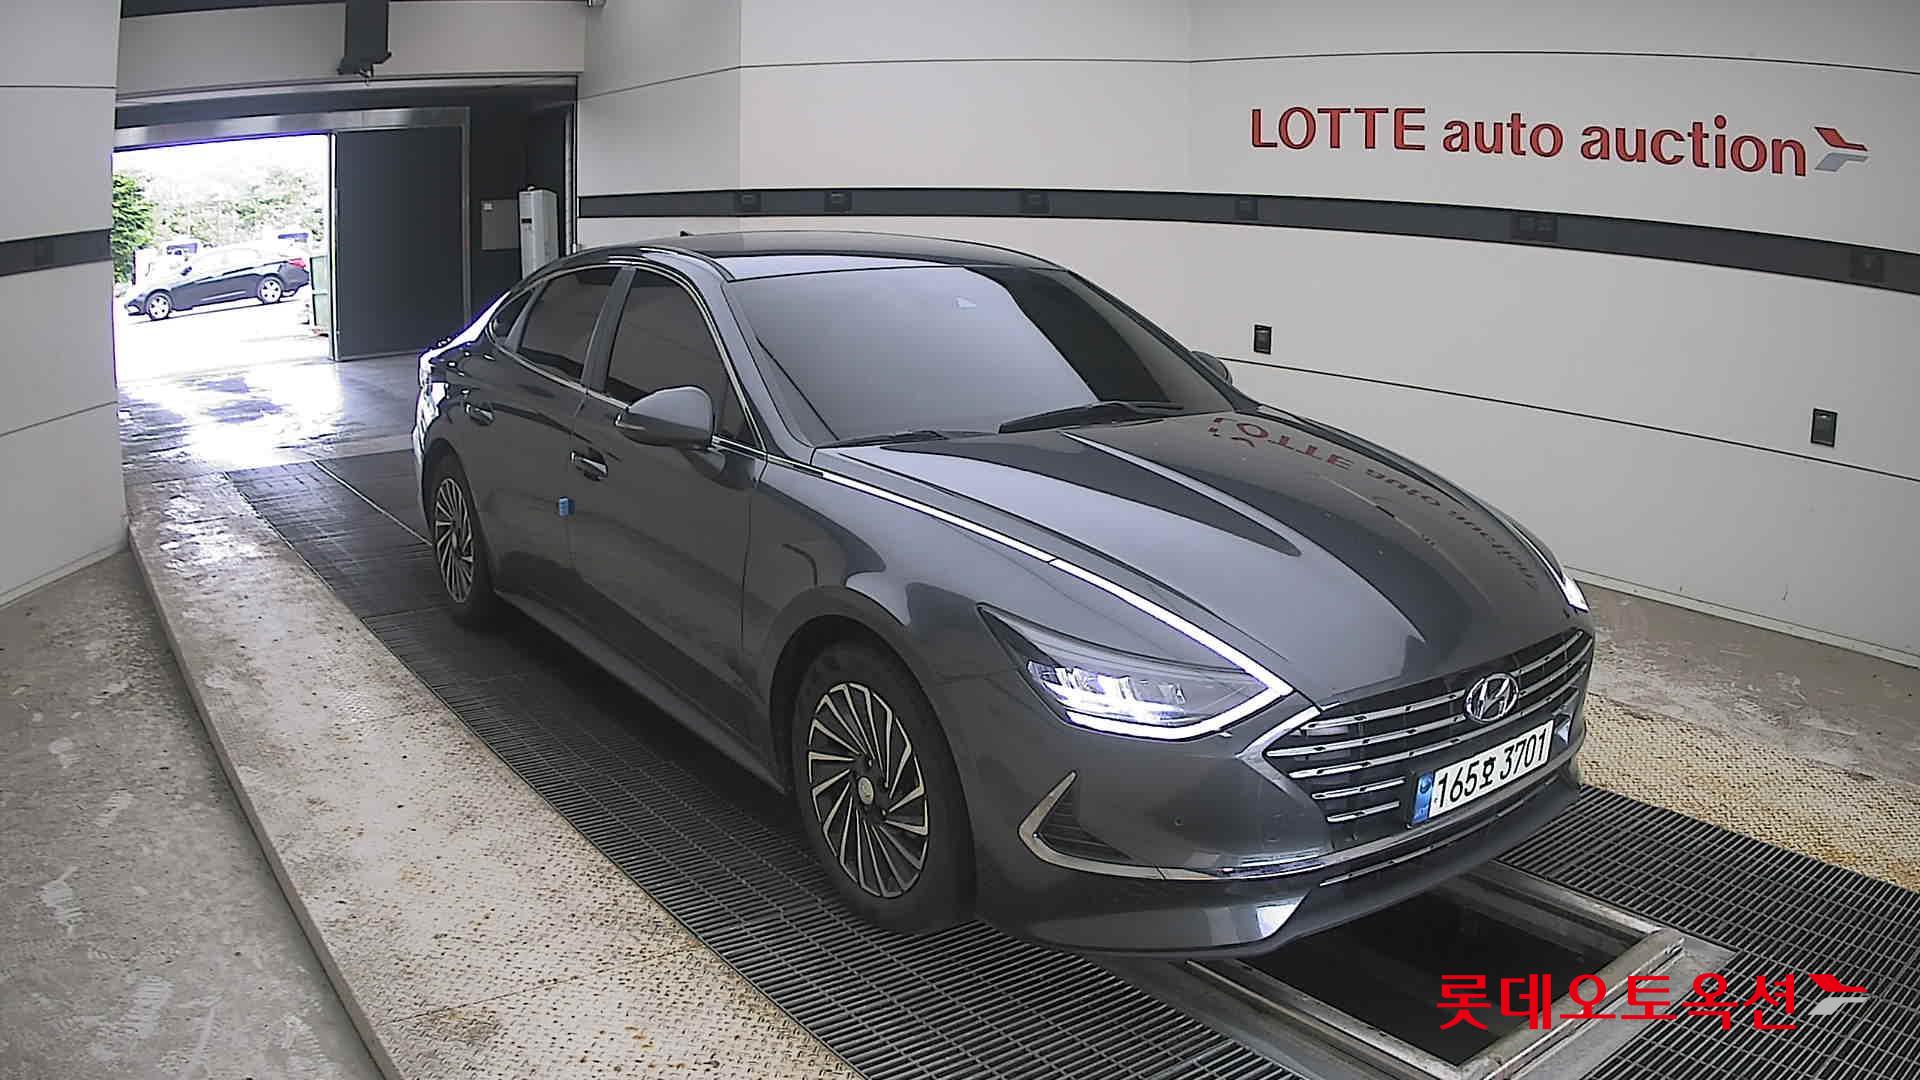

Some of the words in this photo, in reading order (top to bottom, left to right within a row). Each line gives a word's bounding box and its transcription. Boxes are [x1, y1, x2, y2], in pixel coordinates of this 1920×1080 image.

[1250, 106, 1426, 151] LOTTE
[1442, 112, 1564, 158] auto
[1580, 114, 1807, 177] auction
[1437, 755, 1497, 808] 165호
[1500, 727, 1548, 780] 3701
